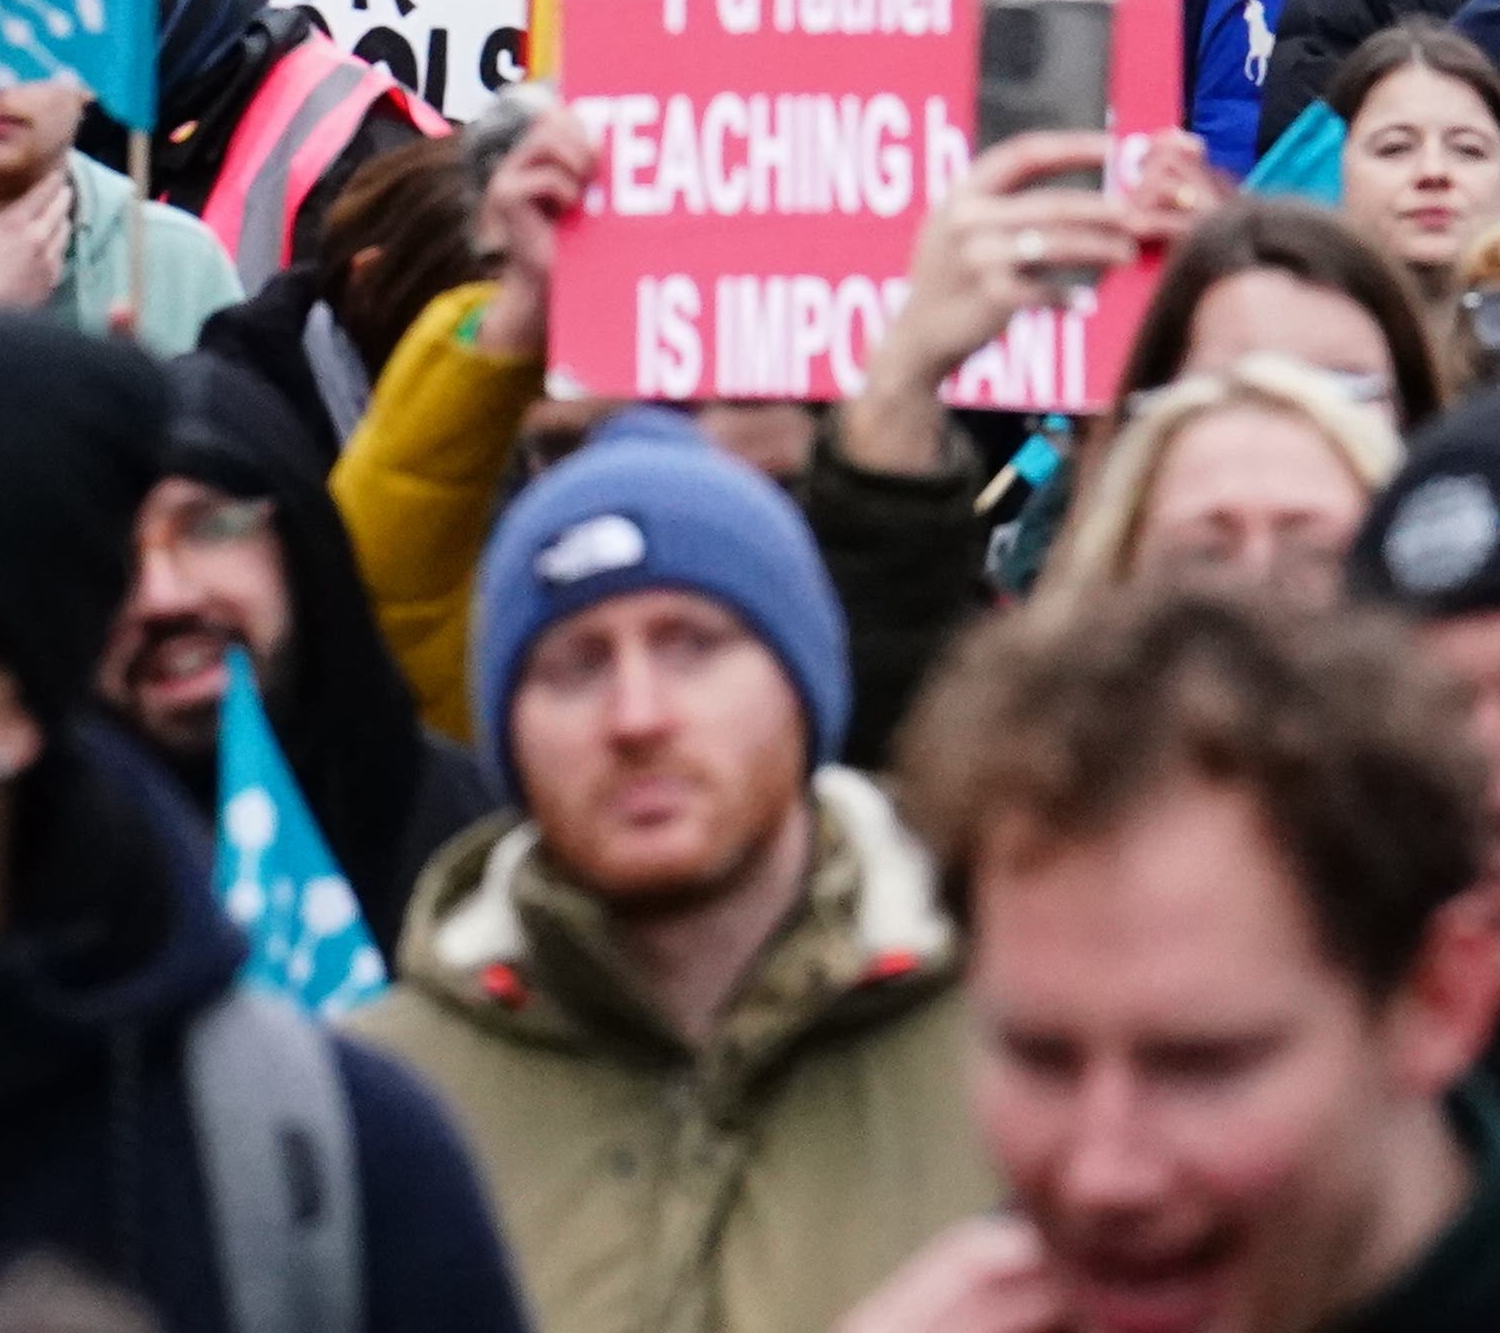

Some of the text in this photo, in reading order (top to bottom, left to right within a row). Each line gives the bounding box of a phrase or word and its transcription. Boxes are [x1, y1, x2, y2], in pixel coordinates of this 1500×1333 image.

[578, 91, 938, 216] TEACHING
[635, 273, 1096, 405] IS IMPOANT
